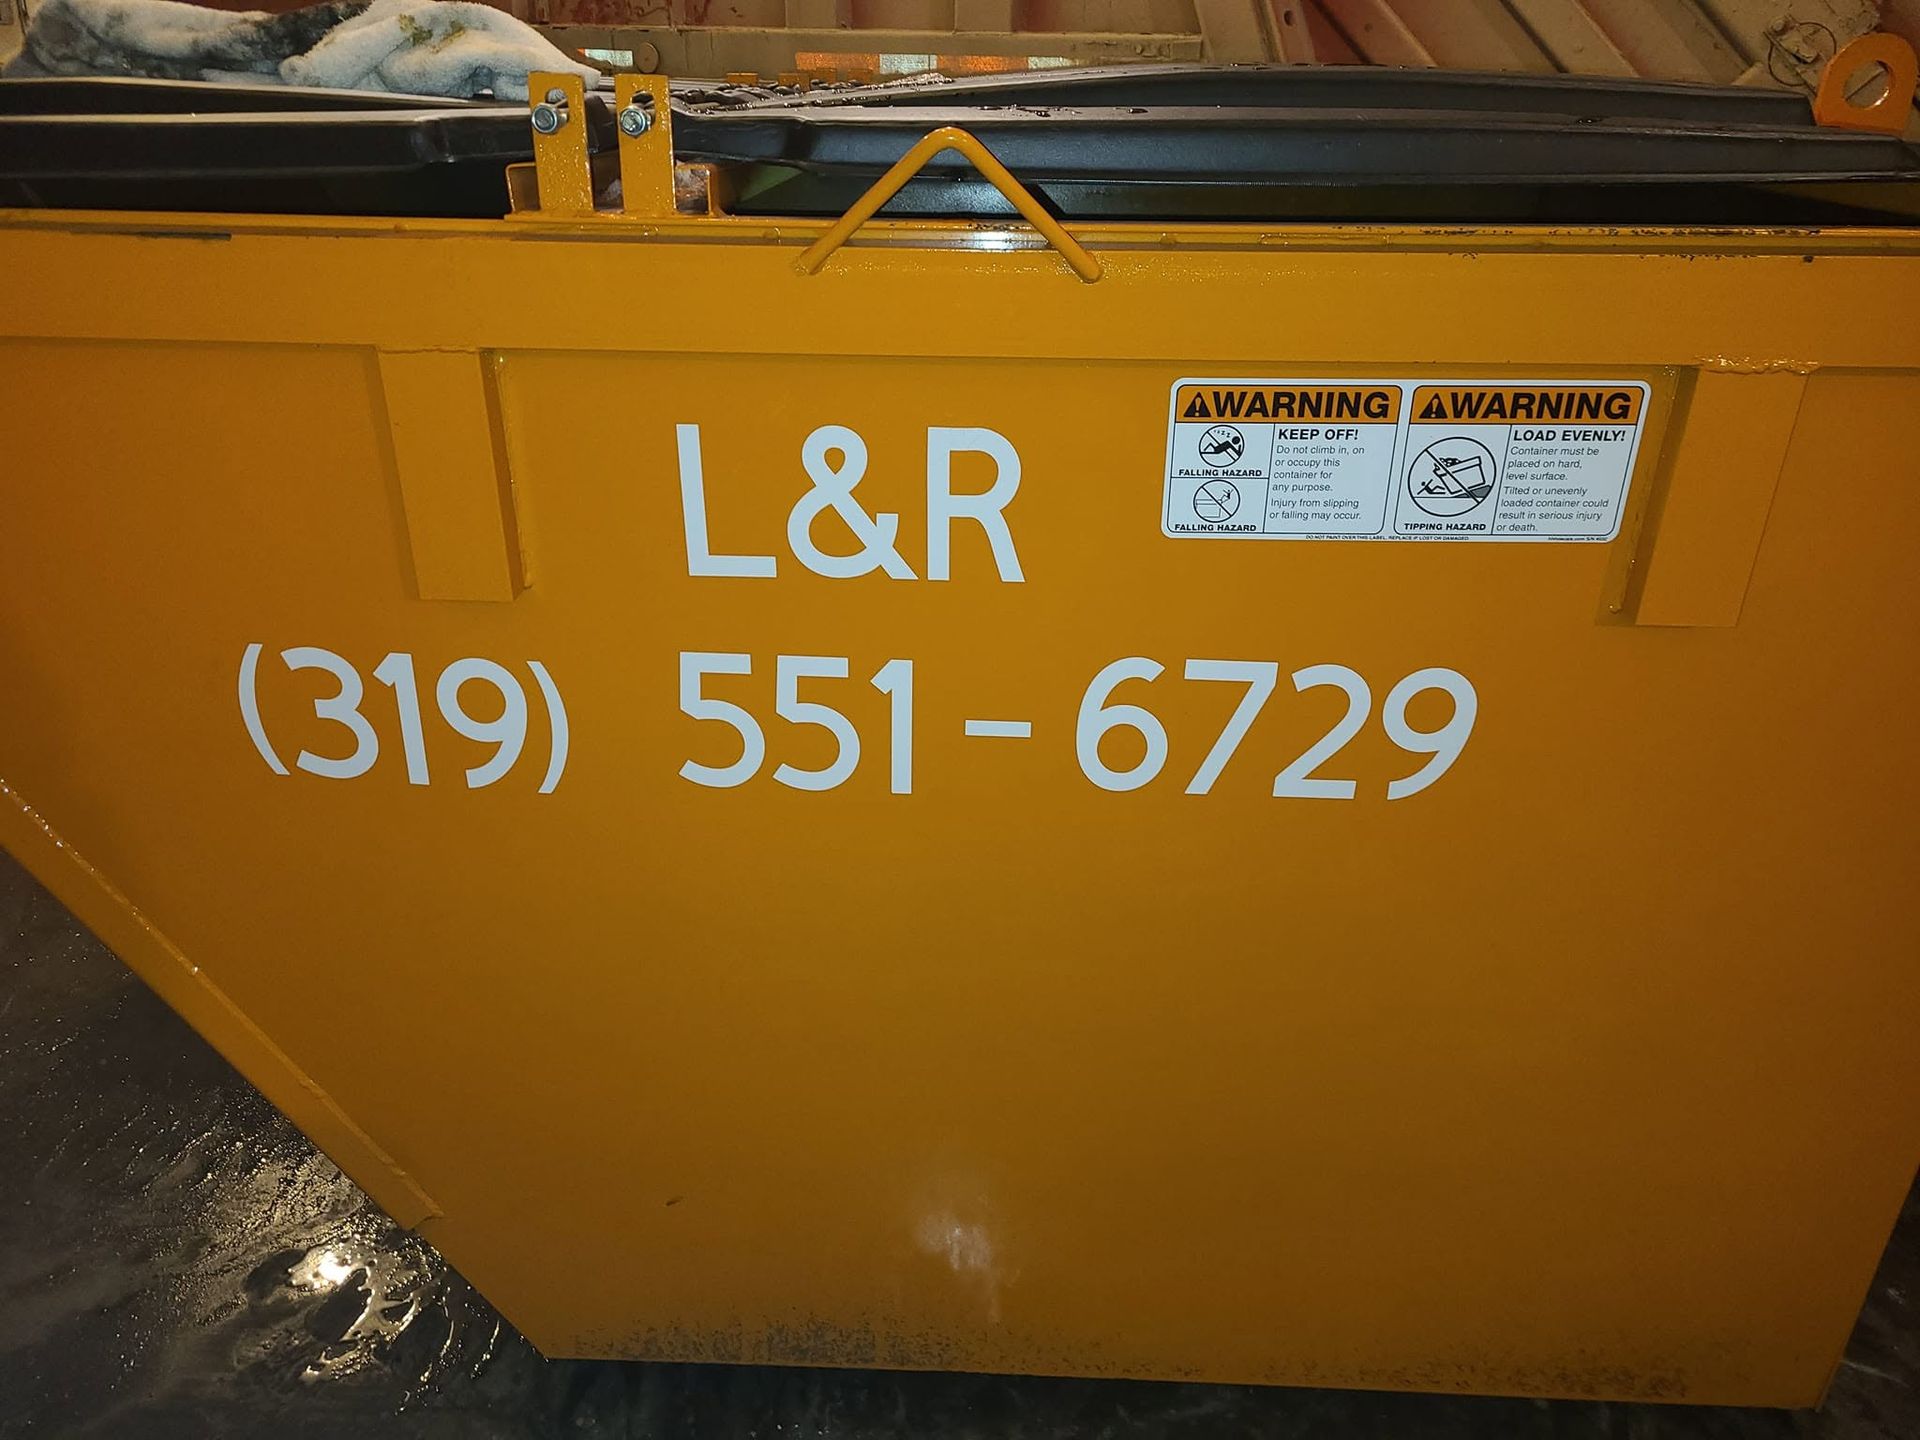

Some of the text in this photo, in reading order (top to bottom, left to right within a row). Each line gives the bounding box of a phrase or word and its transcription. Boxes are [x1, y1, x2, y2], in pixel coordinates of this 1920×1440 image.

[1213, 392, 1389, 418] WARNING
[1450, 392, 1631, 419] WARNING
[1278, 429, 1358, 440] KEEP OFF!
[1514, 430, 1625, 441] LOAD EVENLY!
[1277, 446, 1290, 454] Do
[1310, 446, 1336, 454] climb
[1338, 446, 1350, 455] in,
[1511, 447, 1558, 455] Container
[1587, 447, 1599, 455] be
[1287, 459, 1321, 469] occupy
[1324, 458, 1340, 466] this
[1508, 460, 1540, 470] placed
[1558, 460, 1582, 470] hard,
[1274, 470, 1332, 479] container for
[1506, 472, 1568, 480] level surface.
[1273, 484, 1333, 493] any purpose.
[1504, 486, 1528, 495] Tilted
[1544, 486, 1587, 497] unevenly
[677, 424, 1024, 583] L&R
[1271, 499, 1297, 509] Injury
[1323, 499, 1359, 509] slipping
[1501, 499, 1608, 507] loaded container could
[1281, 511, 1308, 521] falling
[1311, 512, 1331, 521] may
[1499, 511, 1601, 521] result in serious injury
[239, 643, 570, 795] (319)
[679, 652, 914, 794] 551
[1076, 657, 1477, 800] 6729
